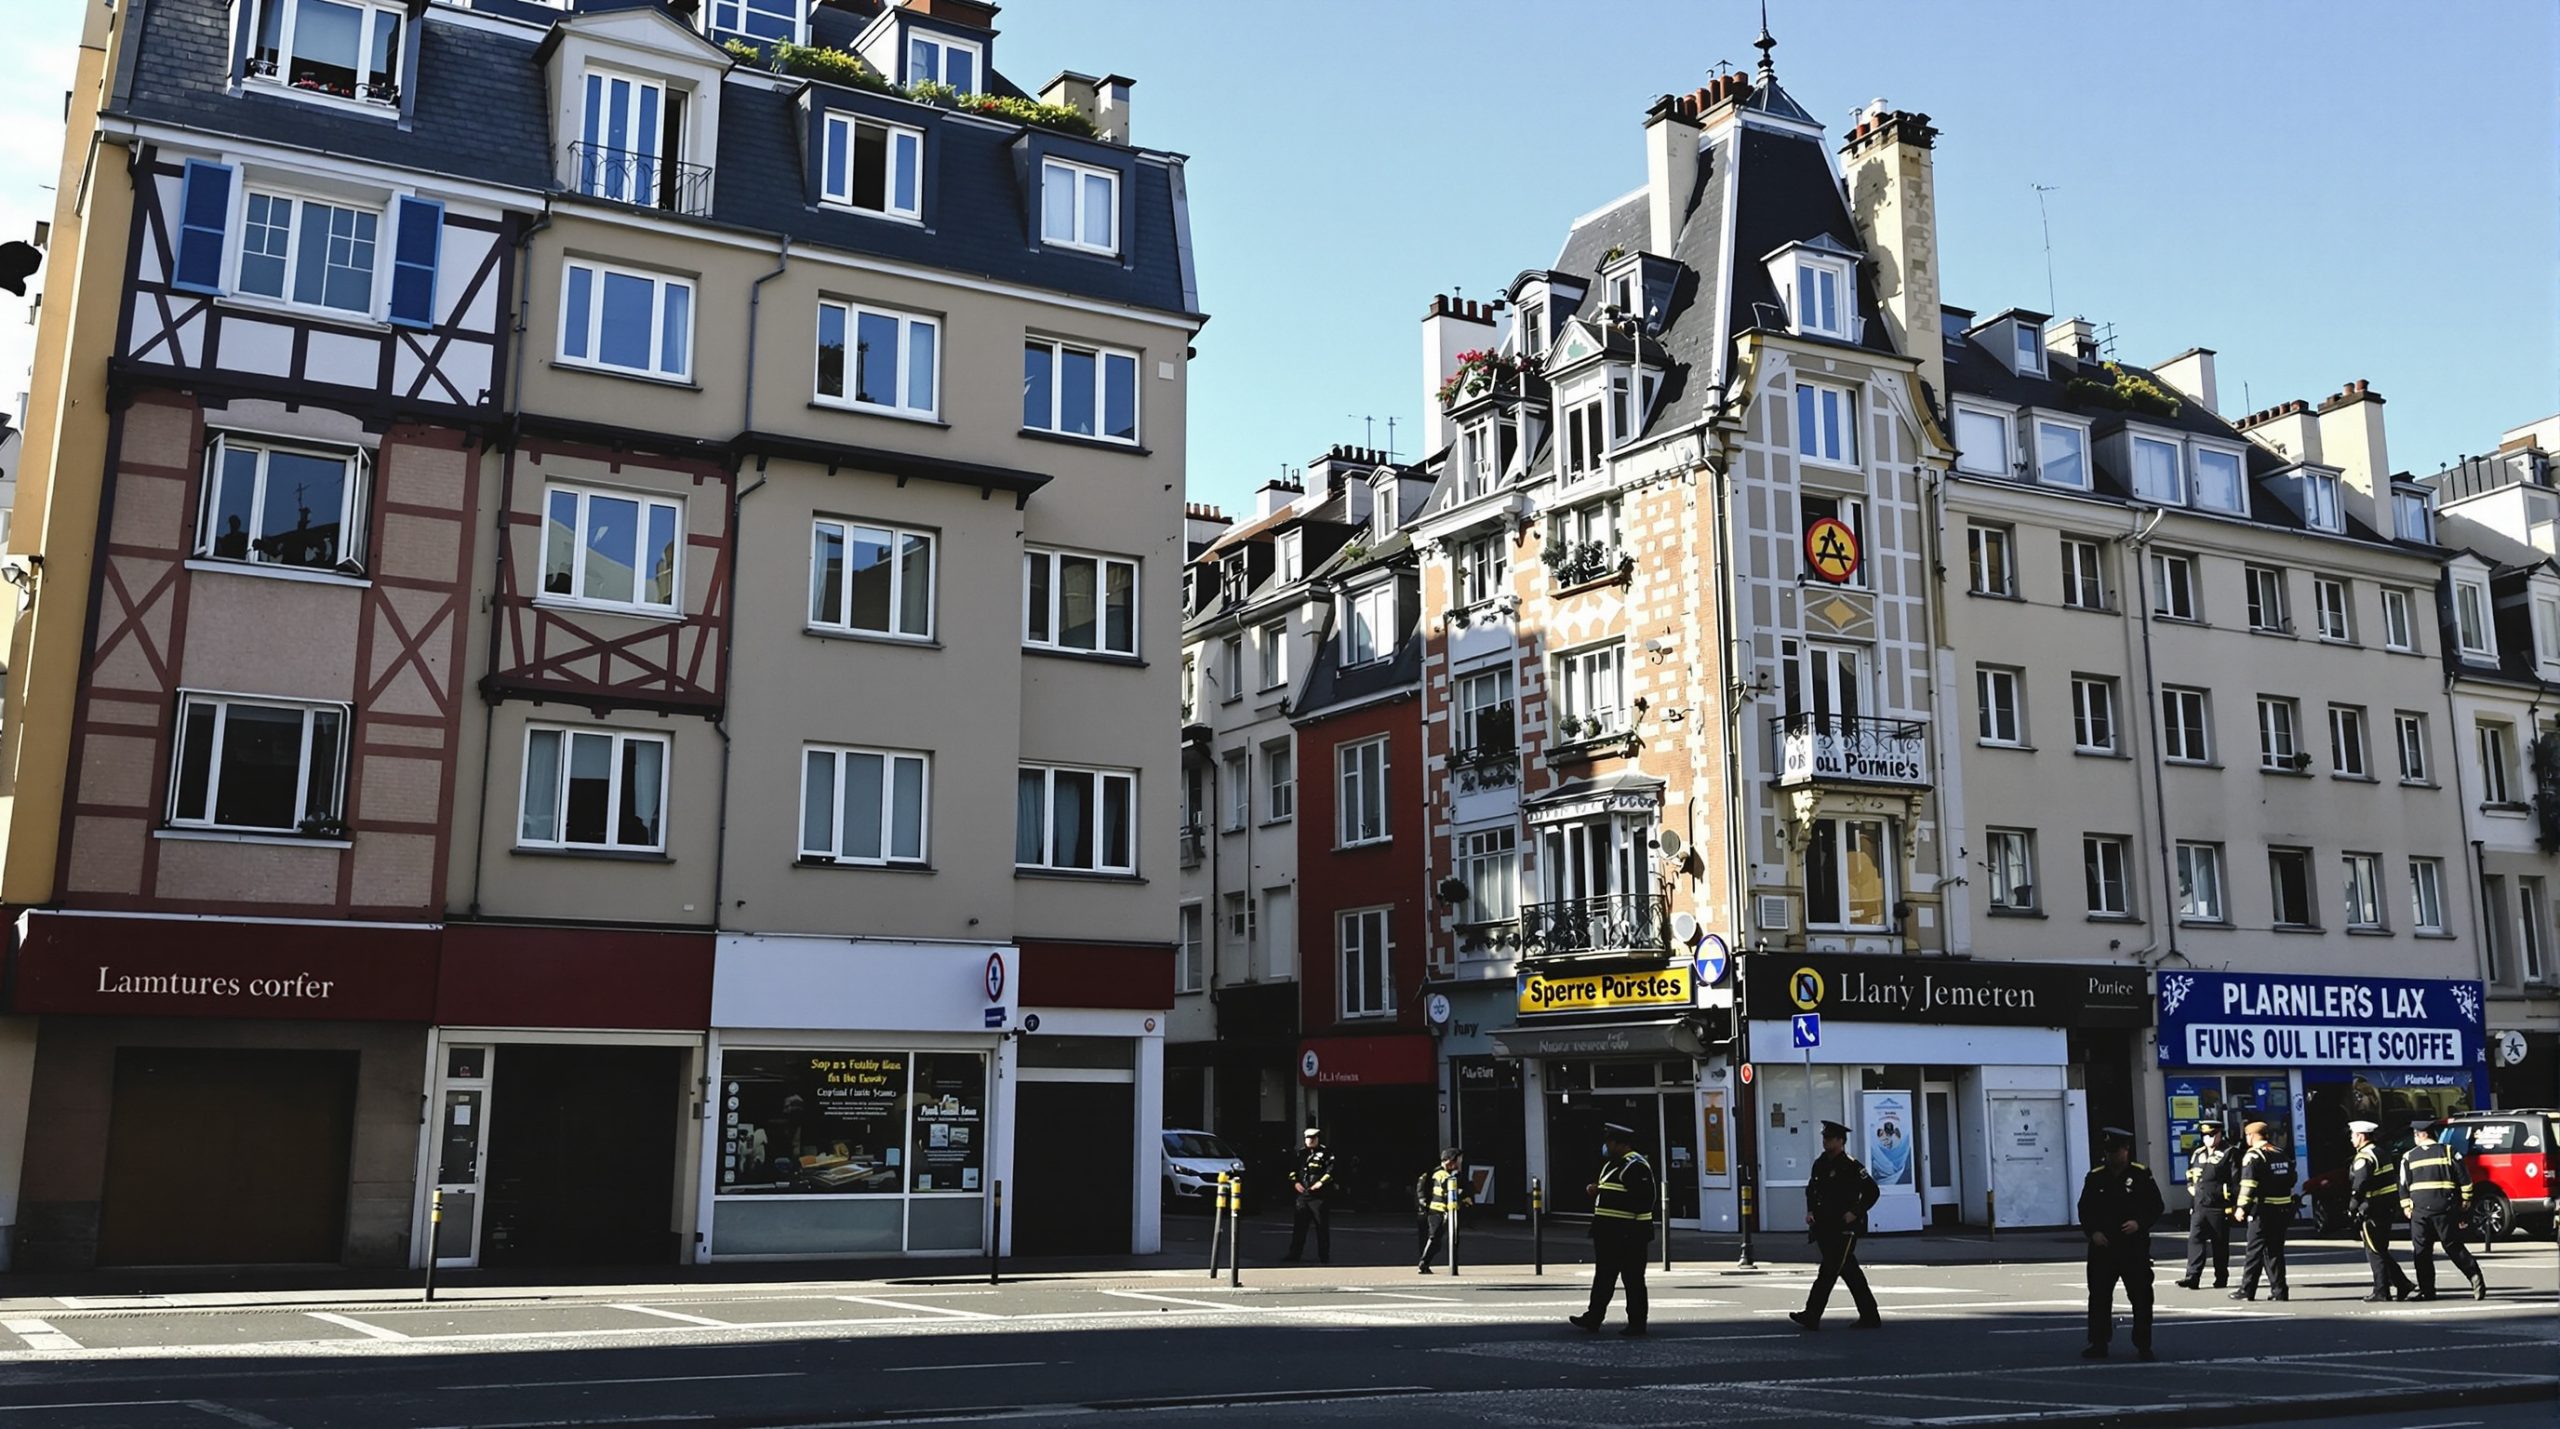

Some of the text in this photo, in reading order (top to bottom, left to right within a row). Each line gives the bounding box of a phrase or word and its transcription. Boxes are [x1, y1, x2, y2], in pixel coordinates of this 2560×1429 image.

[1531, 979, 1597, 1008] Sperre
[2381, 987, 2428, 1019] LAX
[2195, 1028, 2255, 1059] FUNS
[2263, 1029, 2308, 1060] OUL
[2378, 1032, 2455, 1061] SCOFFE
